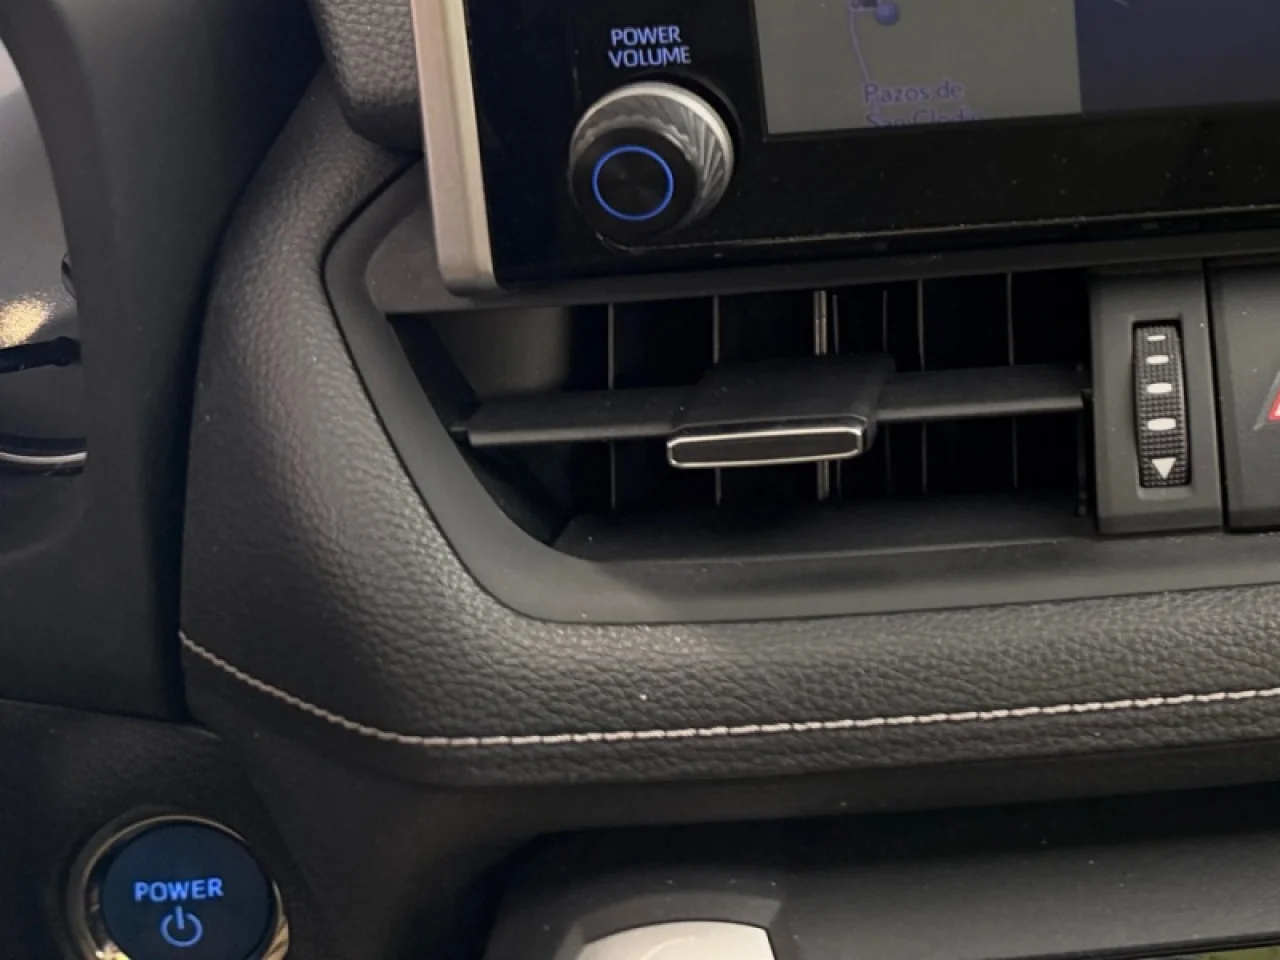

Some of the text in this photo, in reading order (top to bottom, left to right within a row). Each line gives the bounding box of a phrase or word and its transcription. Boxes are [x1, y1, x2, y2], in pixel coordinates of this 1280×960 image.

[611, 26, 681, 46] POWER
[608, 46, 691, 68] VOLUME
[936, 78, 964, 99] de
[133, 877, 224, 902] POWER
